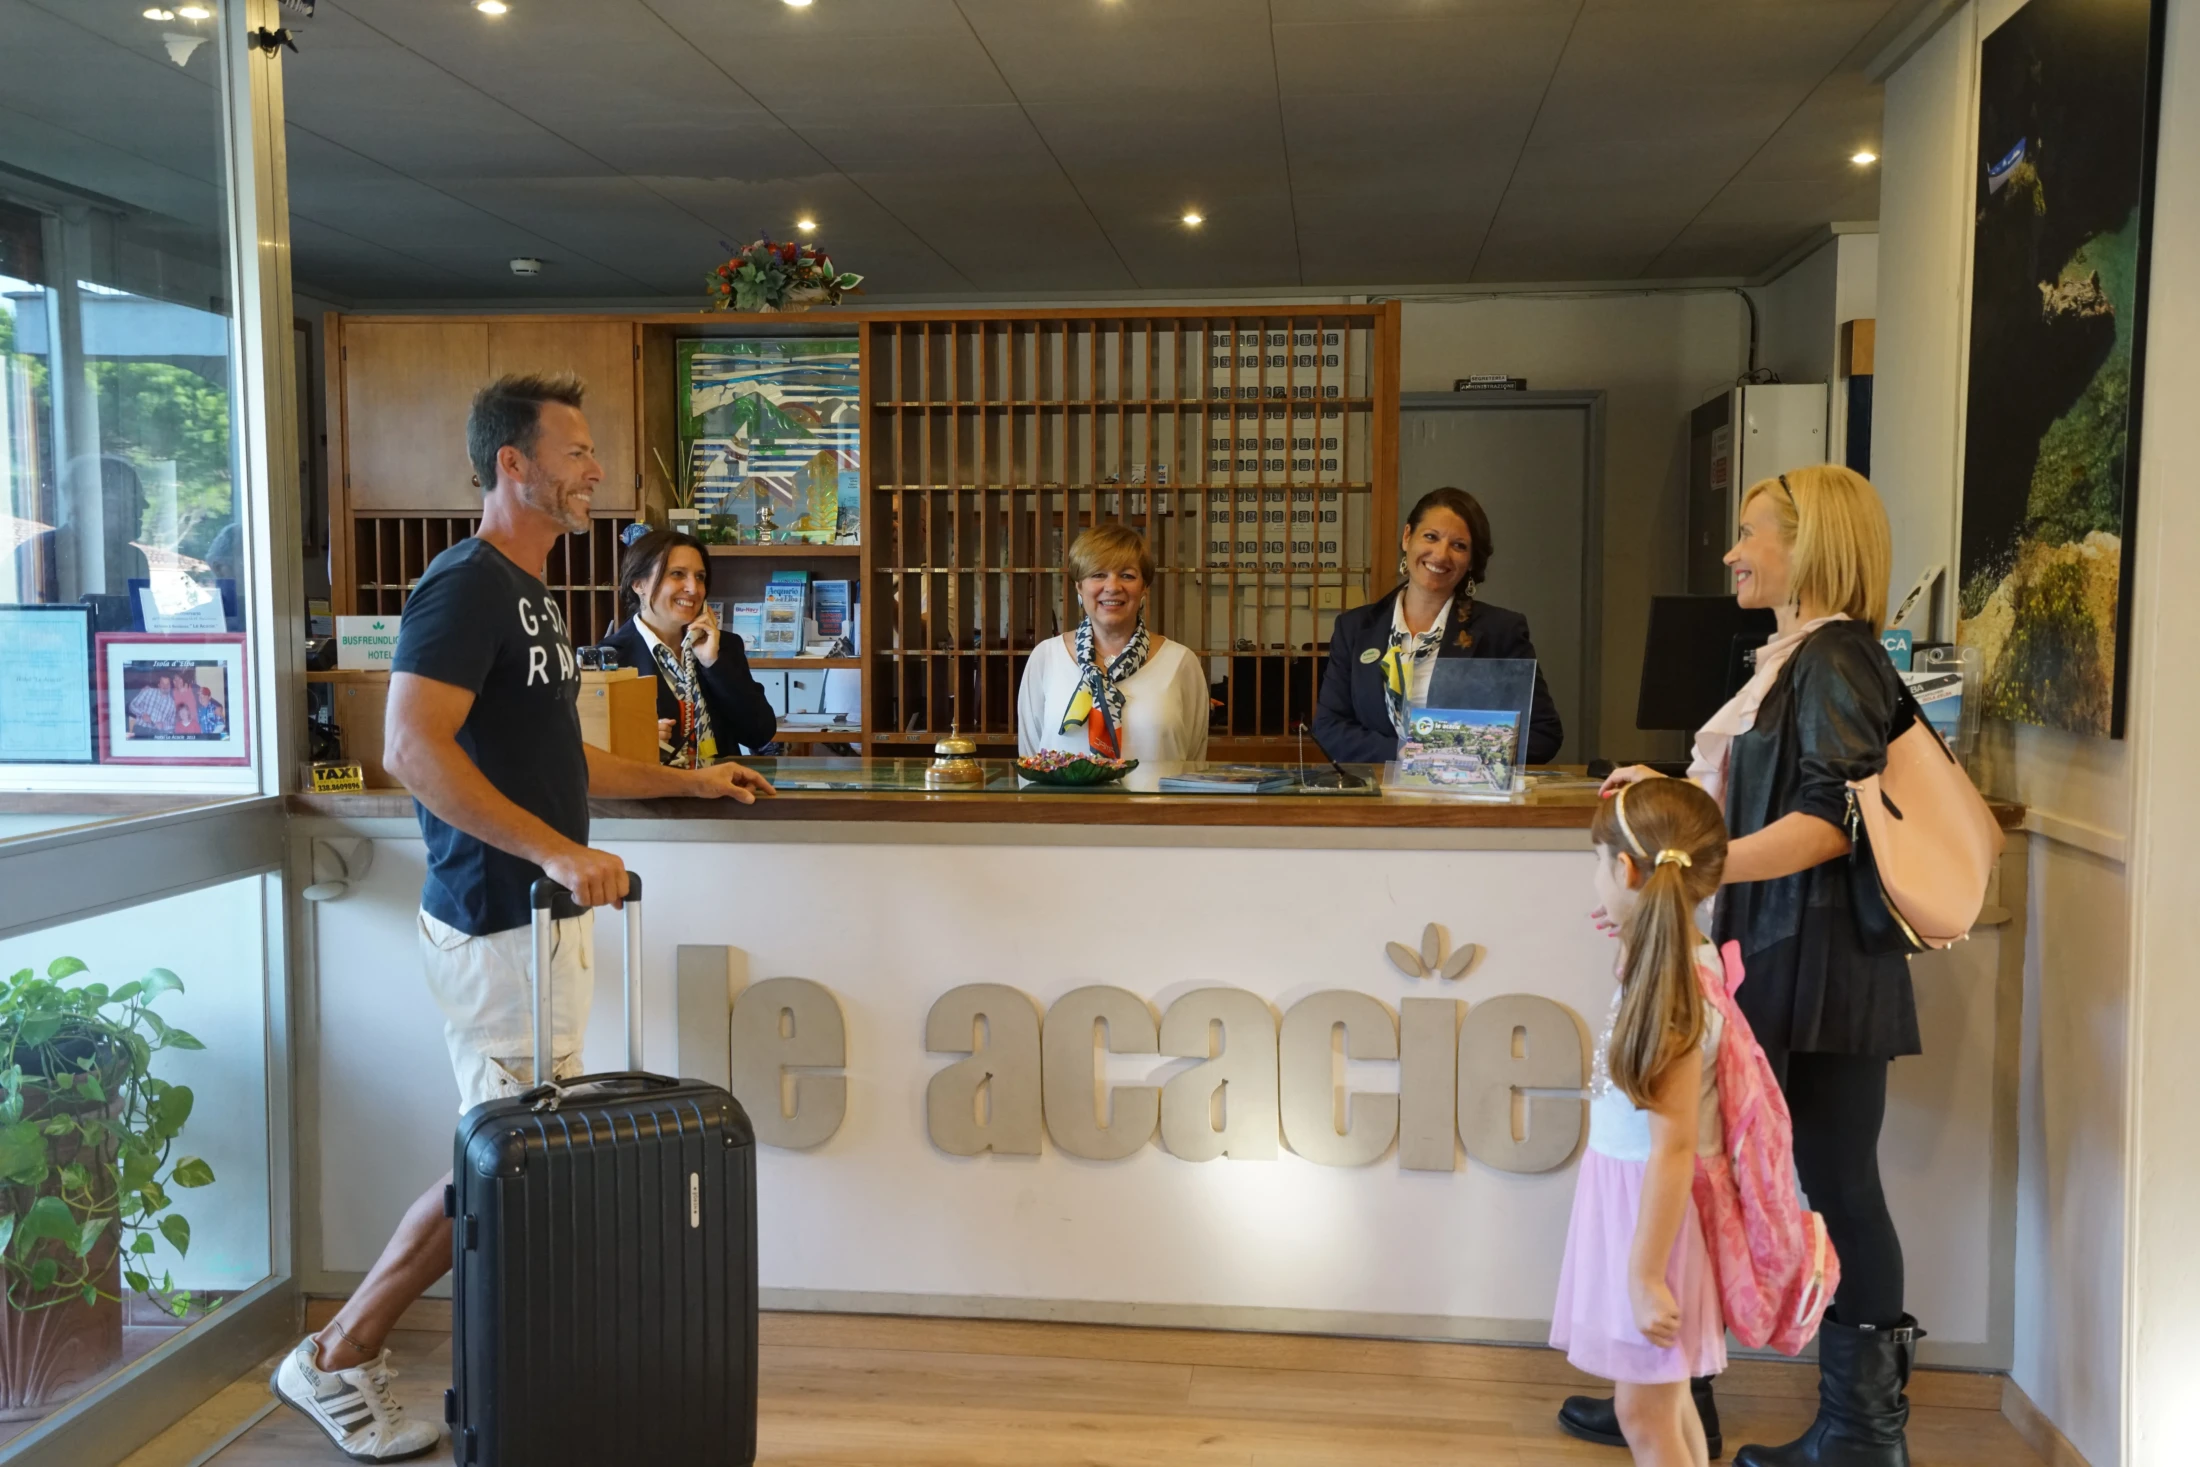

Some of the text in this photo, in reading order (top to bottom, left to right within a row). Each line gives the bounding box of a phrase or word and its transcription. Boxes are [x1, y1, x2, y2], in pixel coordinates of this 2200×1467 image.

[1881, 638, 1908, 651] CA
[368, 650, 393, 660] HOTEL
[315, 768, 358, 780] TAXI
[677, 944, 1584, 1174] le acacie
